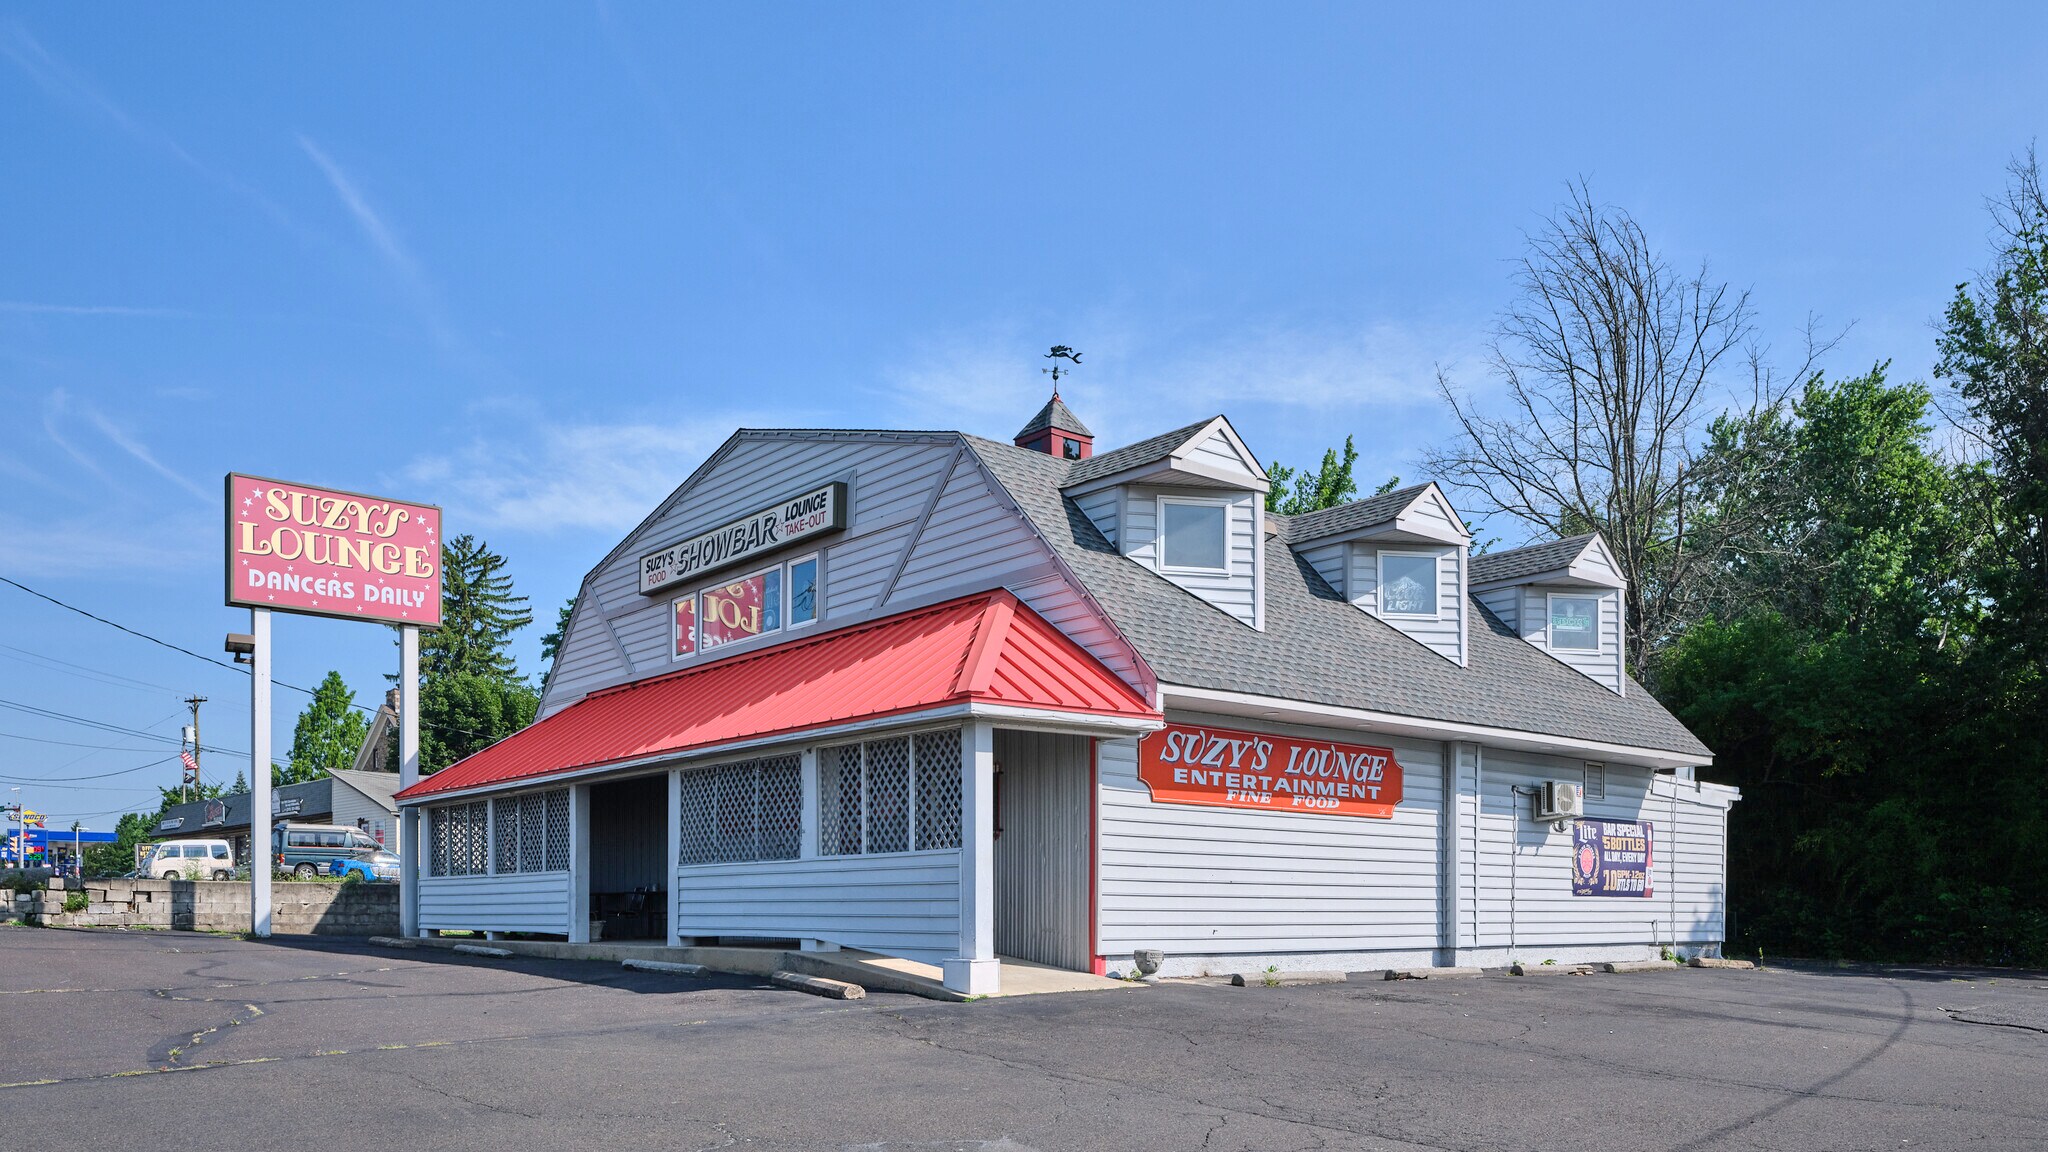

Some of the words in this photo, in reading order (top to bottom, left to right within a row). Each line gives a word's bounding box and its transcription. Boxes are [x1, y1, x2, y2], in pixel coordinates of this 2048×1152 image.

[265, 487, 410, 538] SUZY'S
[785, 491, 828, 522] LOUNGE
[785, 510, 827, 536] TAKE-OUT
[238, 521, 435, 579] LOUNGE
[676, 511, 779, 576] SHOWBAR
[645, 550, 675, 574] SUZY'S
[248, 568, 356, 600] DANCERS
[364, 584, 425, 608] DAILY
[648, 570, 667, 586] FOOD
[1159, 730, 1274, 771] SUZY'S
[1284, 745, 1388, 782] LOUNGE
[1173, 768, 1382, 800] ENTERTAINMENT
[1226, 789, 1273, 805] FINE
[1291, 796, 1341, 809] FOOD
[1578, 824, 1597, 843] Lite
[1602, 822, 1617, 836] BAR
[1616, 823, 1645, 838] SPECIAL
[1611, 837, 1646, 851] BOTTLES
